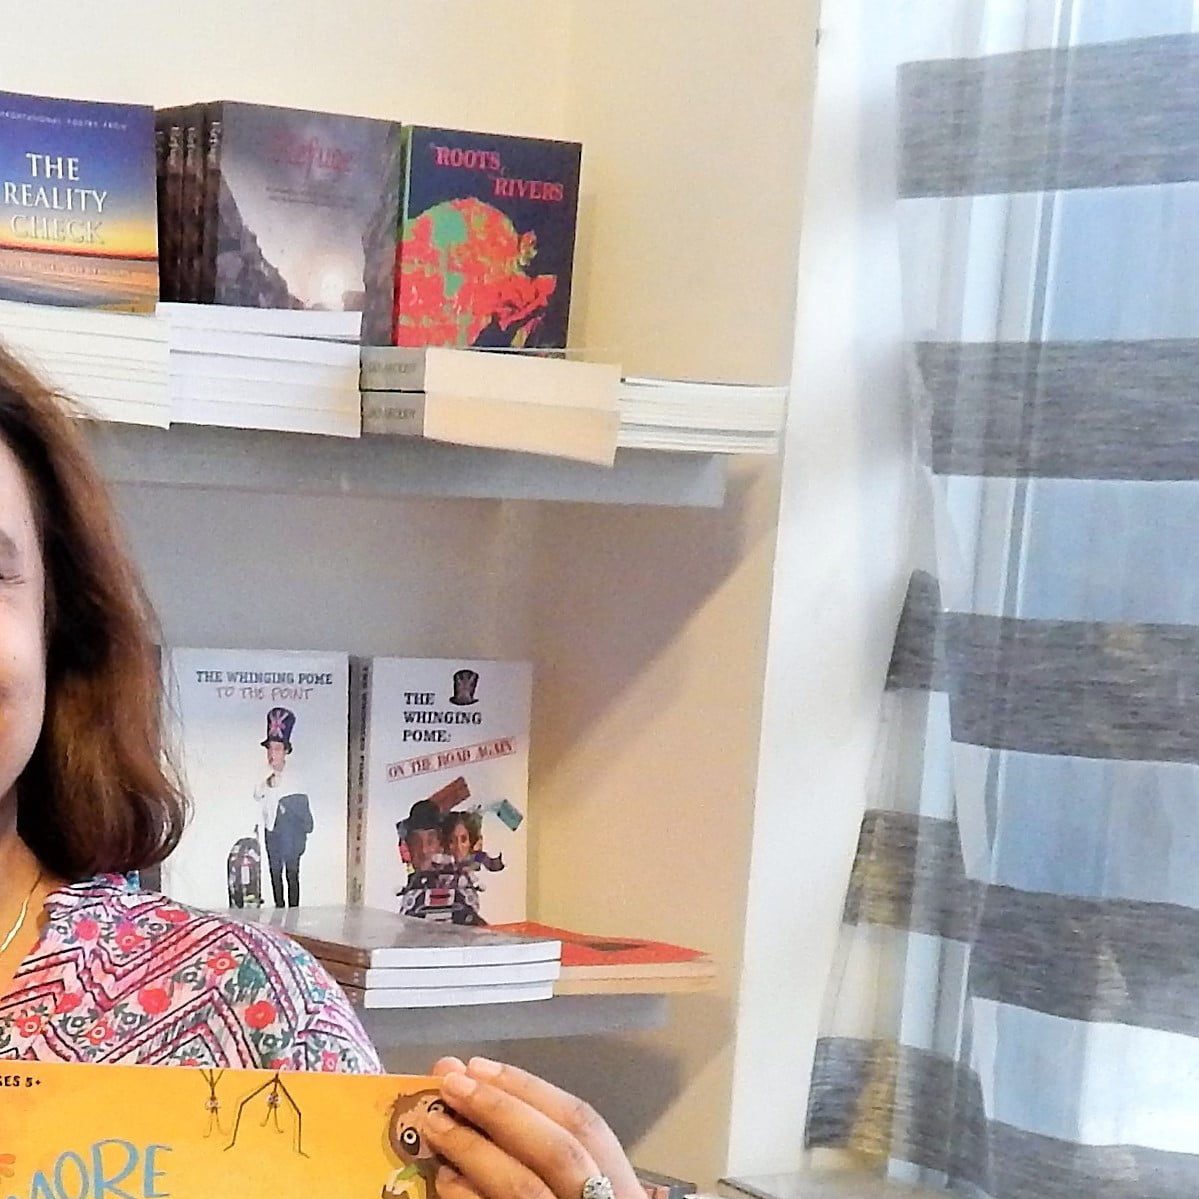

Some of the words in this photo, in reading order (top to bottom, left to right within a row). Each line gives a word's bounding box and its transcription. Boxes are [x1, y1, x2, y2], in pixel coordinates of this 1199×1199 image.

[26, 152, 80, 181] THE
[4, 181, 108, 213] REALITY
[493, 177, 564, 201] RIVERS
[11, 215, 105, 244] CHECK
[196, 671, 223, 683] THE
[226, 671, 295, 684] WHINGING
[298, 673, 333, 685] POME
[216, 686, 235, 699] TO
[271, 687, 314, 701] POINT
[404, 692, 435, 705] THE
[403, 711, 482, 724] WHINGING
